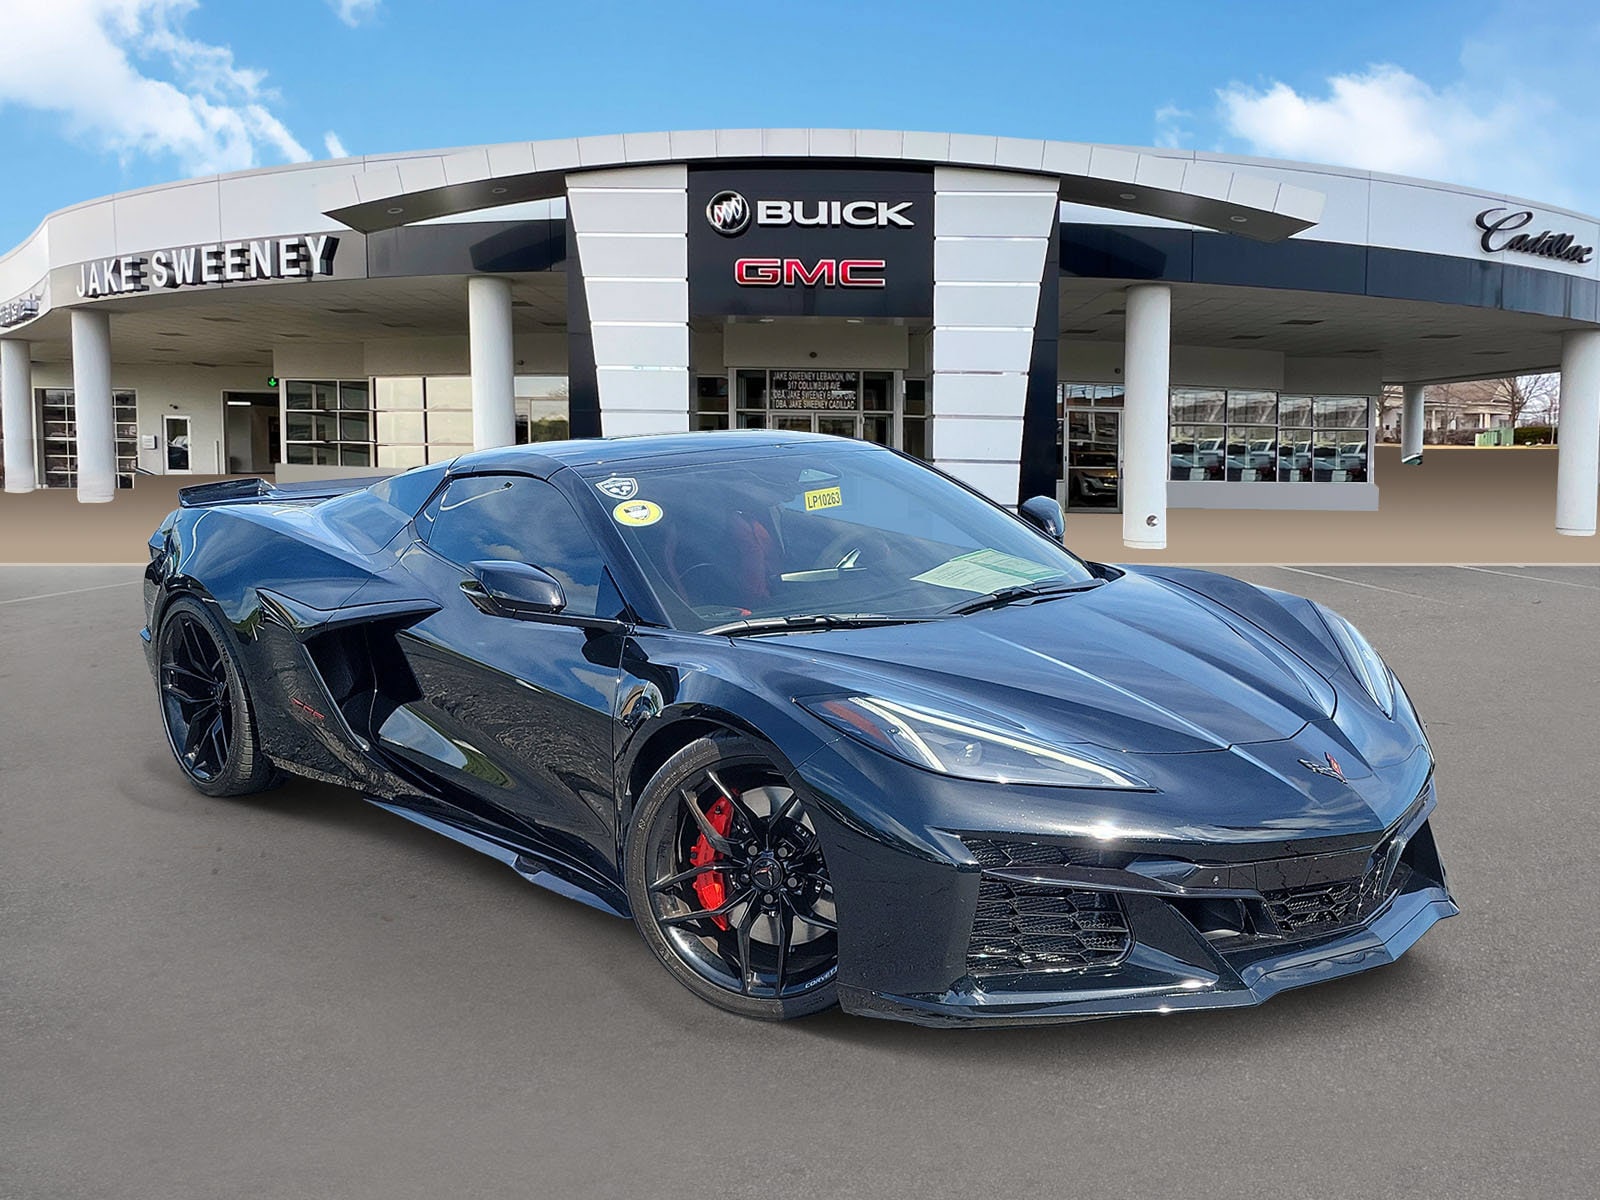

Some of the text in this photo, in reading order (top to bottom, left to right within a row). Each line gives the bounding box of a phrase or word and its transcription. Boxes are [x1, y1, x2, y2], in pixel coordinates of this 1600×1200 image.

[757, 200, 915, 227] BUICK
[1475, 207, 1593, 264] Cadillac
[76, 234, 338, 298] JAKE SWEENEY
[734, 258, 886, 286] GMC
[773, 371, 787, 381] JAKE
[788, 371, 815, 381] SWEENEY
[807, 491, 840, 508] LP10263
